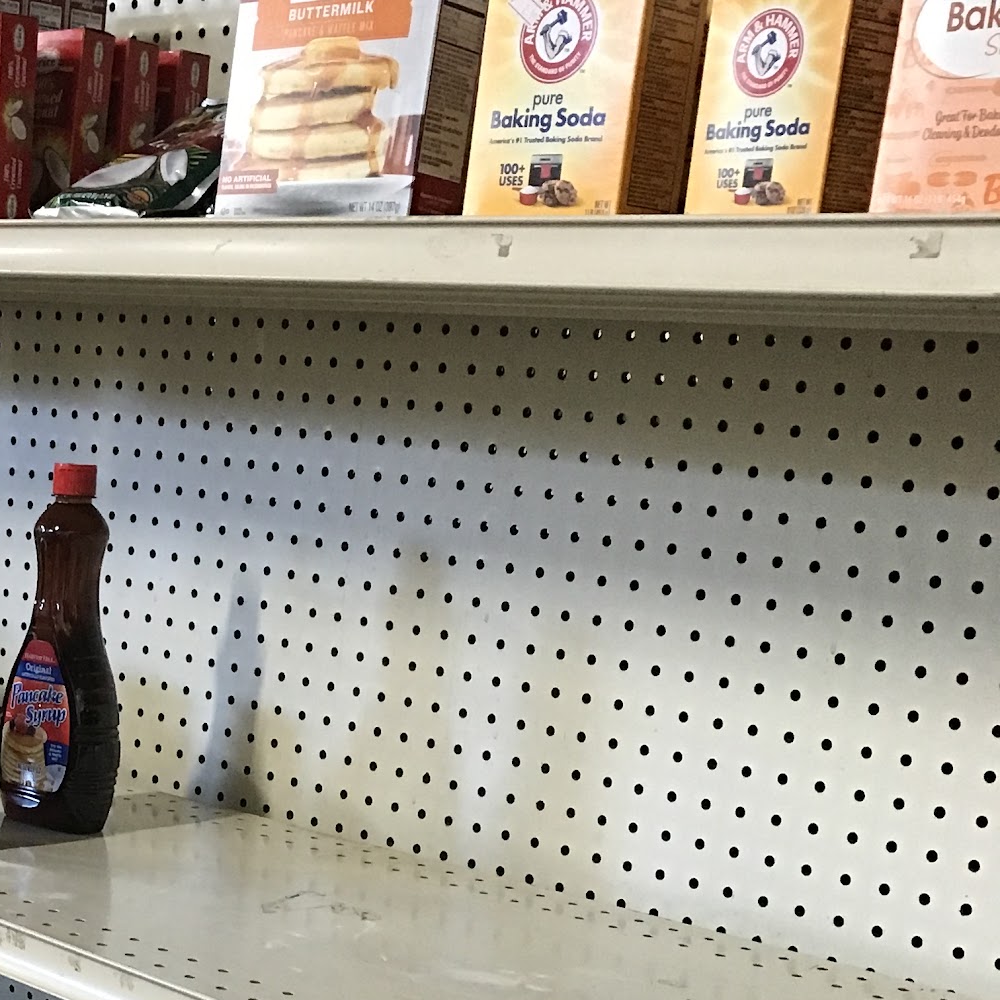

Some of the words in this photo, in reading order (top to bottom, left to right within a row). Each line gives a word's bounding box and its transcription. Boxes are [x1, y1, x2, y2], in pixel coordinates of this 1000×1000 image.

[288, 1, 374, 22] BUTTERMILK
[946, 2, 1000, 32] Bak
[736, 31, 756, 63] ARM
[754, 21, 764, 33] &
[765, 14, 800, 58] HAMMER
[533, 93, 563, 110] pure
[491, 108, 552, 133] Baking
[555, 106, 606, 127] Soda
[744, 106, 772, 122] pure
[935, 110, 960, 126] Great
[962, 110, 977, 122] For
[706, 122, 762, 142] Baking
[764, 118, 810, 137] Soda
[922, 127, 961, 141] Cleaning
[500, 163, 525, 174] 100+
[717, 168, 740, 179] 100+
[221, 175, 232, 183] NO
[233, 174, 271, 183] ARTIFICIAL
[499, 176, 523, 186] USES
[716, 178, 738, 189] USES
[25, 662, 52, 674] Original
[11, 682, 64, 709] Pancake
[25, 705, 67, 728] Syrup
